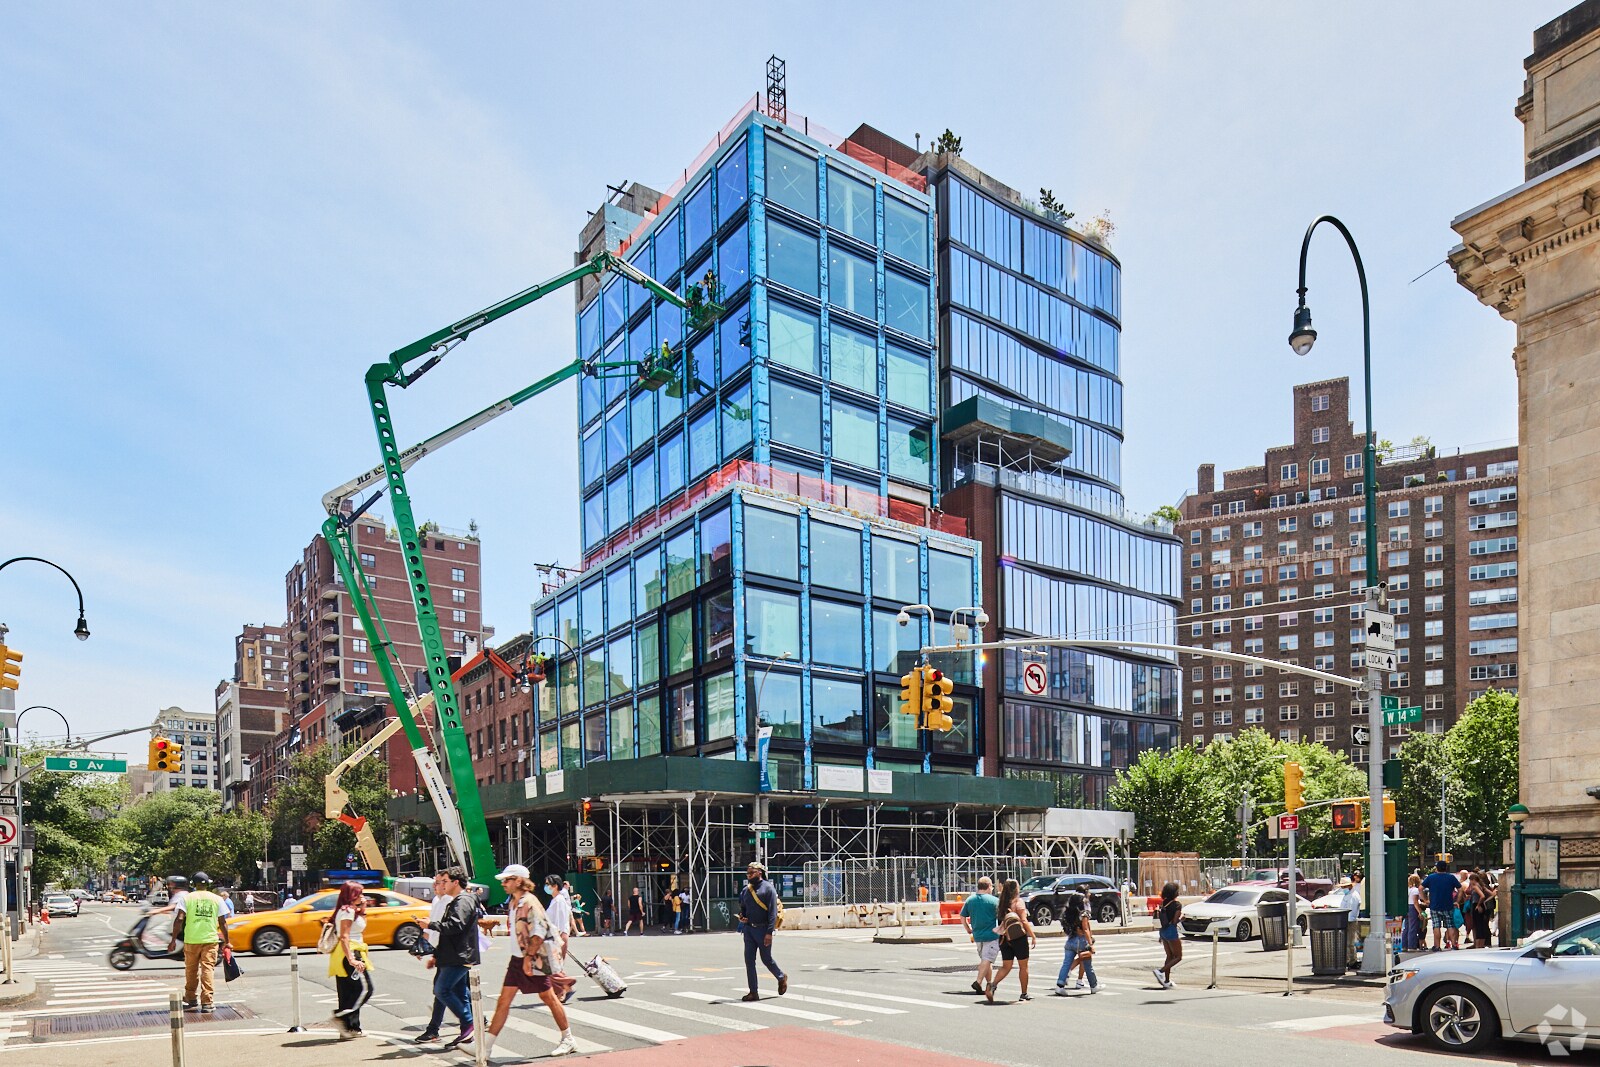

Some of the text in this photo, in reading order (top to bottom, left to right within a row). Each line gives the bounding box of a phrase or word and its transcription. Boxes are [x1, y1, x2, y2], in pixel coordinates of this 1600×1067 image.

[357, 472, 371, 486] JLG
[1381, 620, 1393, 630] TRUCK
[1381, 634, 1394, 642] ROUTE
[1368, 654, 1384, 666] LOCAL
[1387, 712, 1394, 723] W
[1398, 710, 1406, 722] 14
[69, 760, 104, 770] 8 Av
[579, 838, 593, 846] 25
